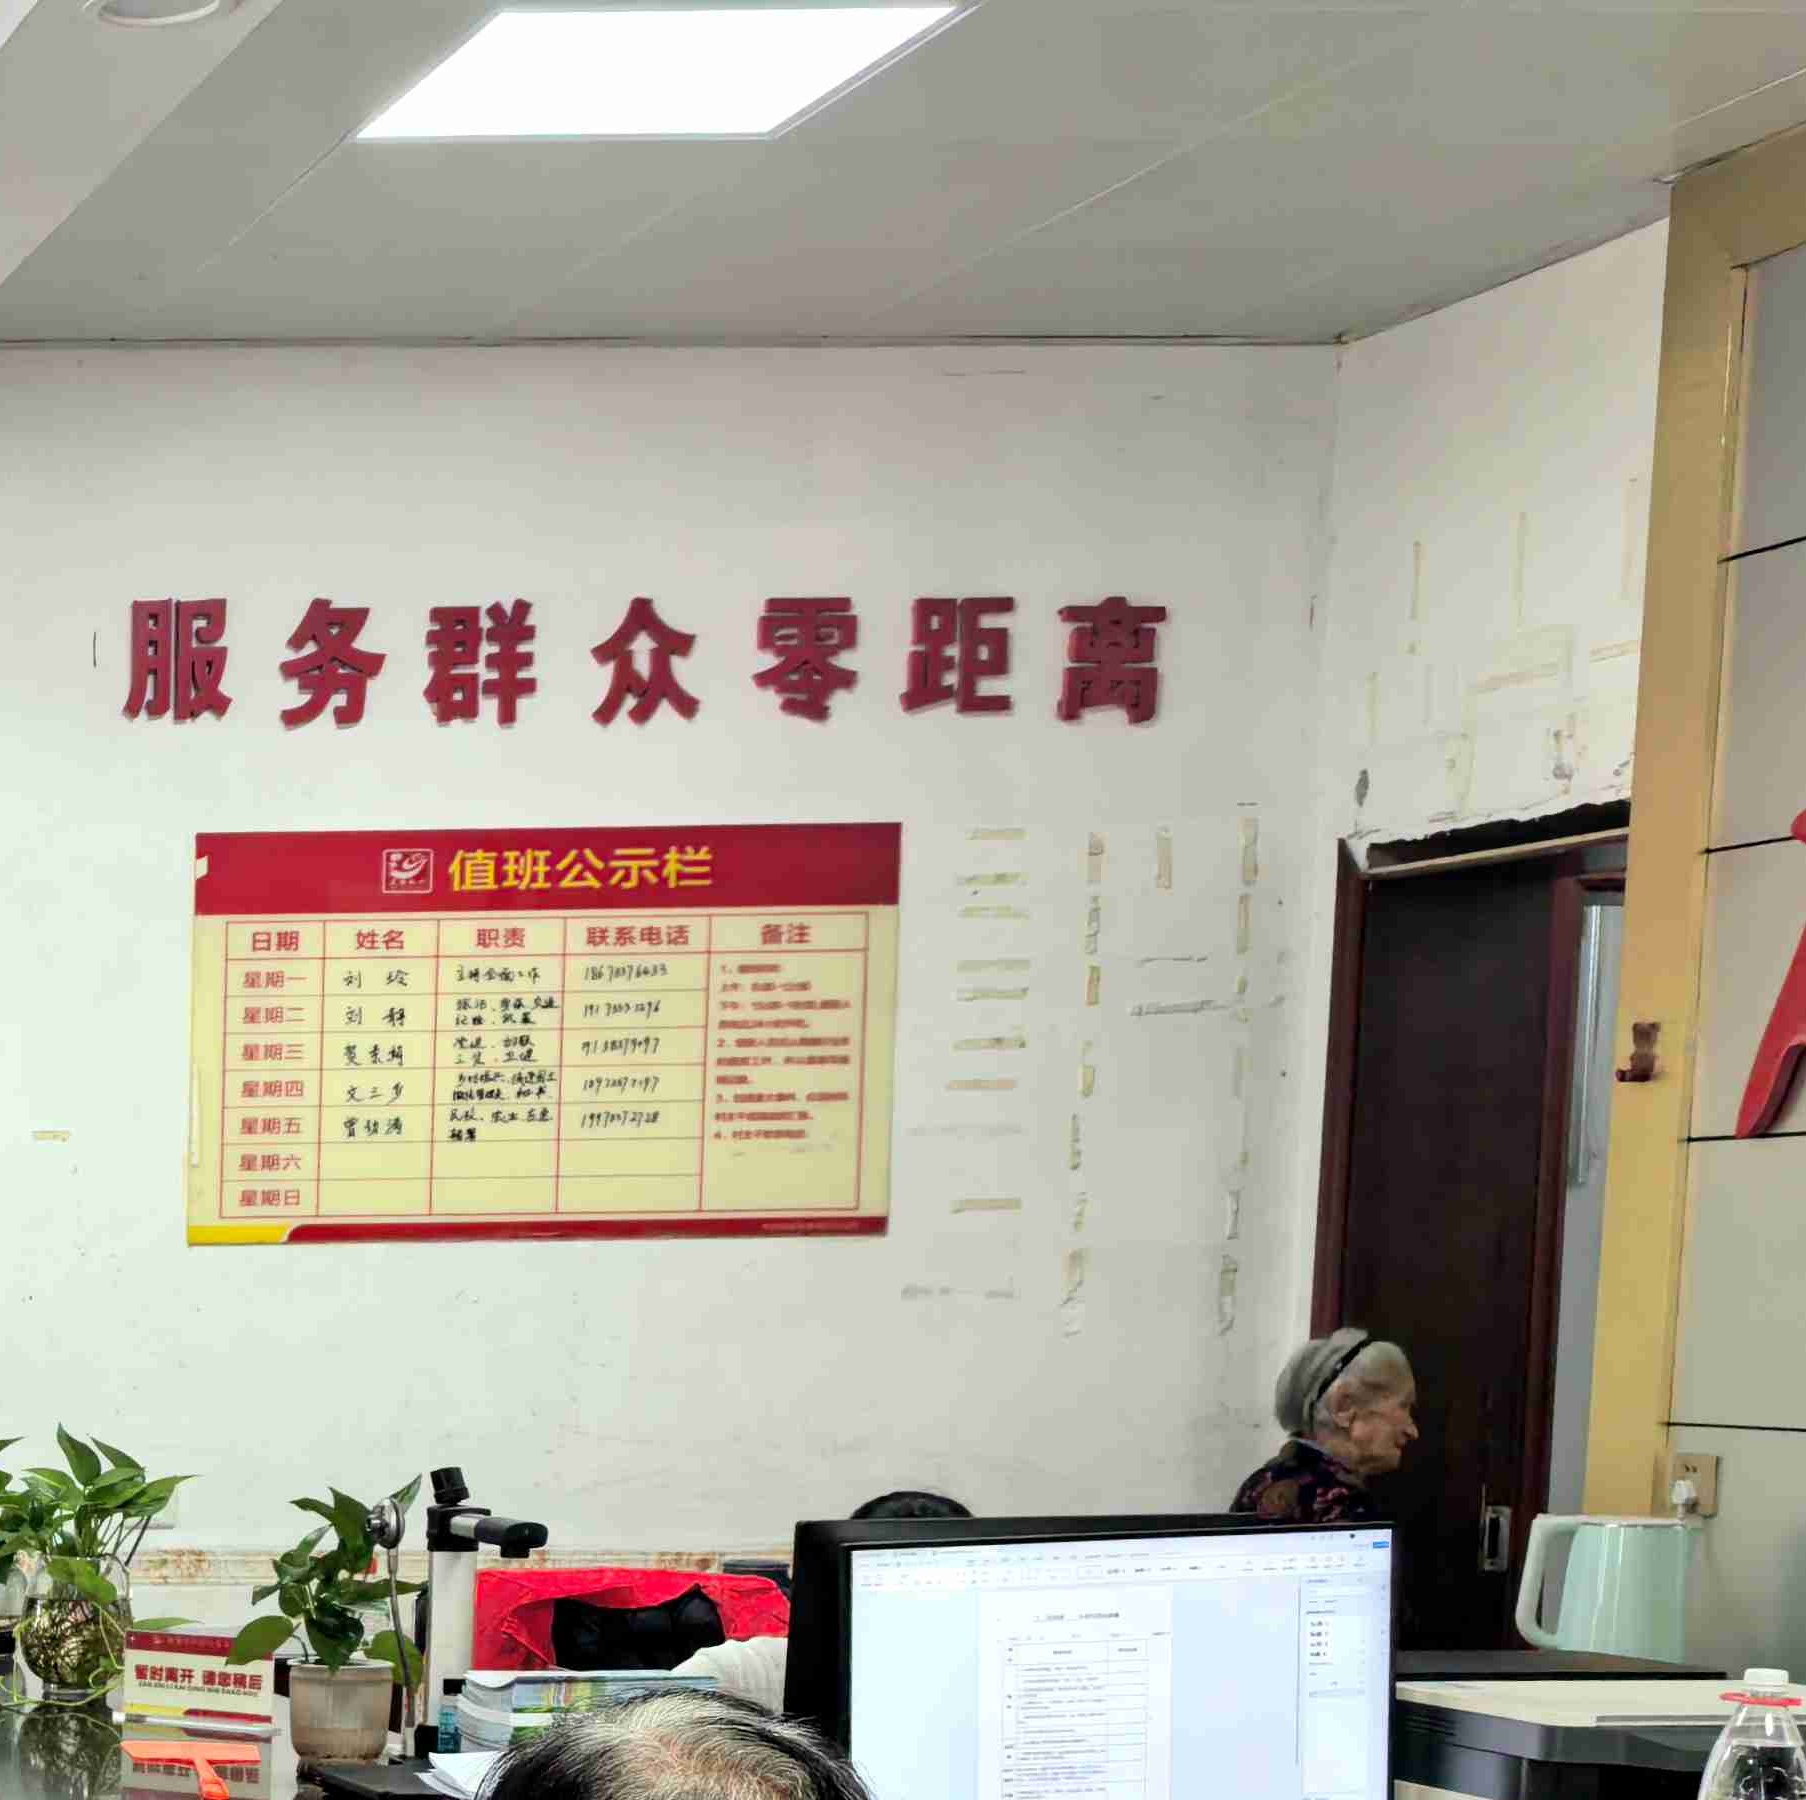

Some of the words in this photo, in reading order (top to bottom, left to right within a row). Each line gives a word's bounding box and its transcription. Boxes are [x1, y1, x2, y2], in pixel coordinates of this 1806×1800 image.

[123, 597, 1168, 728] 服务群众零距离
[449, 846, 714, 891] 值班公示栏
[251, 930, 300, 951] 日期
[355, 929, 404, 950] 姓名
[476, 927, 526, 948] 职责
[585, 925, 690, 947] 联系电话
[760, 923, 810, 944] 备注
[242, 971, 308, 987] 星期一
[242, 1007, 305, 1023] 星期二
[242, 1044, 304, 1061] 星期三
[241, 1081, 303, 1098] 星期四
[240, 1117, 302, 1134] 星期五
[239, 1153, 302, 1171] 星期六
[239, 1189, 301, 1206] 星期日
[135, 1664, 194, 1683] 暂时离开
